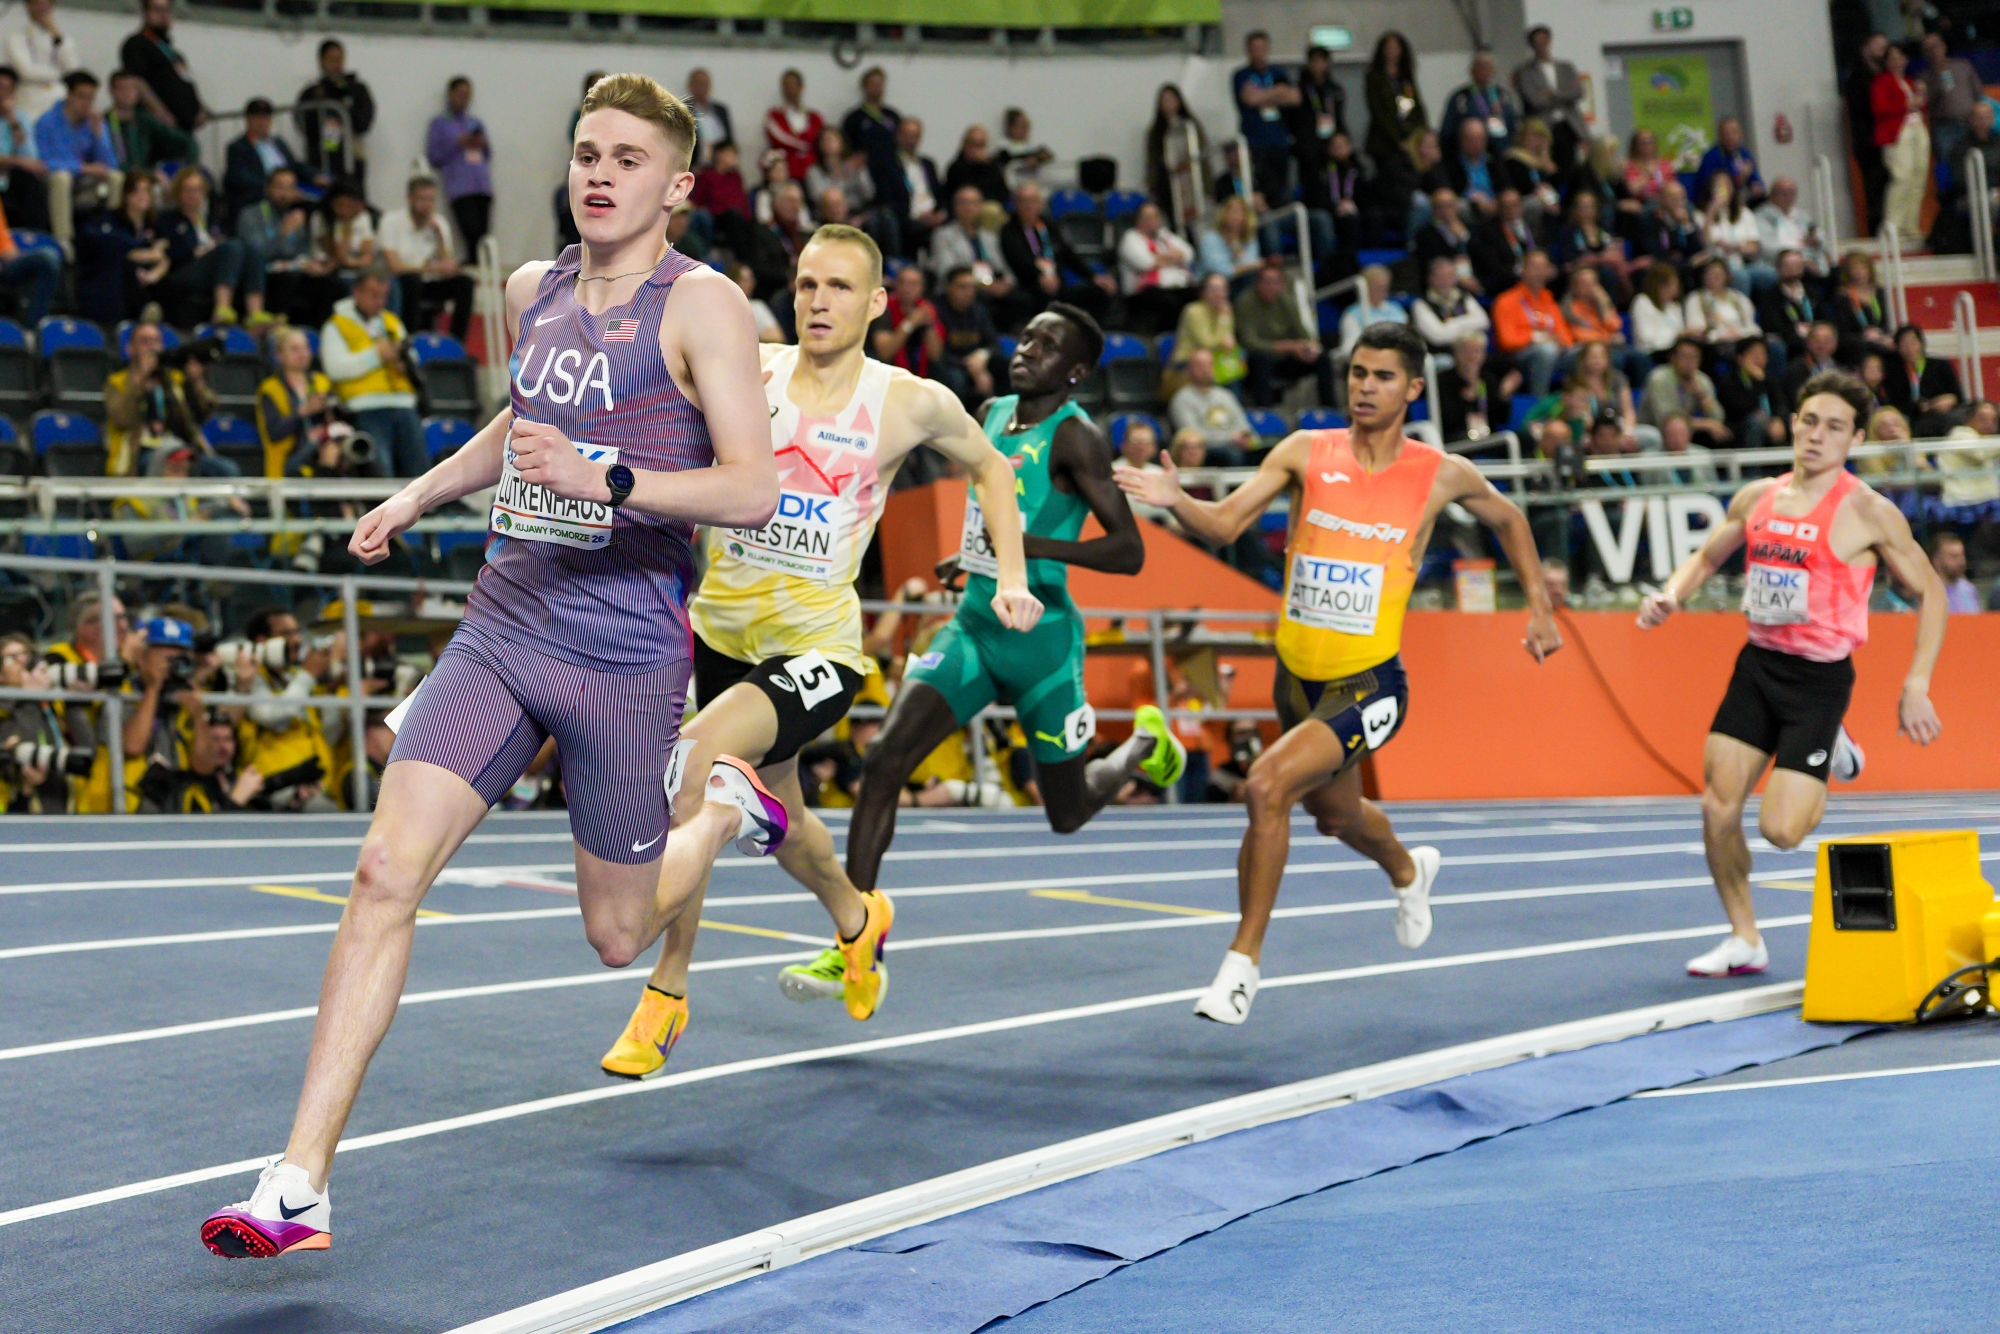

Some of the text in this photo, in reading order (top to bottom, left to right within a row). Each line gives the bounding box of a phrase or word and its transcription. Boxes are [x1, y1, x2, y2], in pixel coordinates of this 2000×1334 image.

[516, 344, 614, 411] USA
[817, 431, 853, 445] Allianz
[515, 522, 605, 544] KUJAWY POMORZE 26
[1305, 508, 1408, 544] ESPAÑA
[1580, 492, 1727, 583] VIP
[1752, 541, 1809, 564] JAPAN
[1307, 561, 1373, 587] TDK
[1759, 570, 1801, 589] TDK
[1291, 583, 1374, 613] ATTAOUI
[1751, 588, 1795, 611] CLAY
[799, 664, 830, 691] 5
[1076, 711, 1087, 739] 6
[1370, 713, 1390, 732] 3
